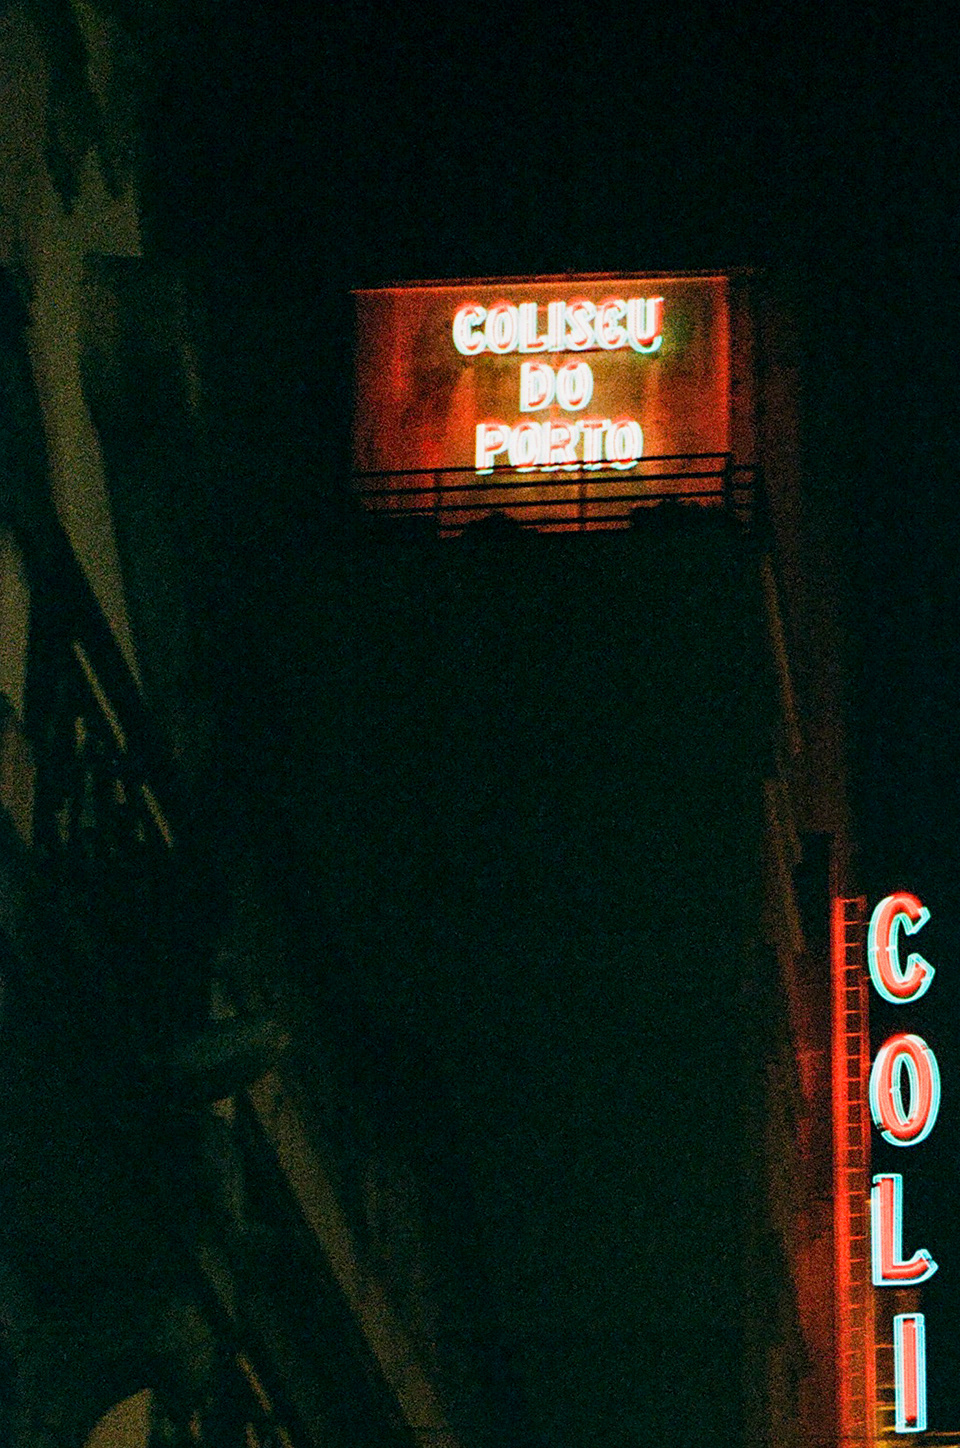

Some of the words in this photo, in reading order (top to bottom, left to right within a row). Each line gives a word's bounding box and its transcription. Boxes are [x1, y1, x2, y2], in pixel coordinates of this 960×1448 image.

[452, 296, 664, 356] COLISEU
[520, 361, 594, 412] DO
[475, 418, 644, 475] PORTO
